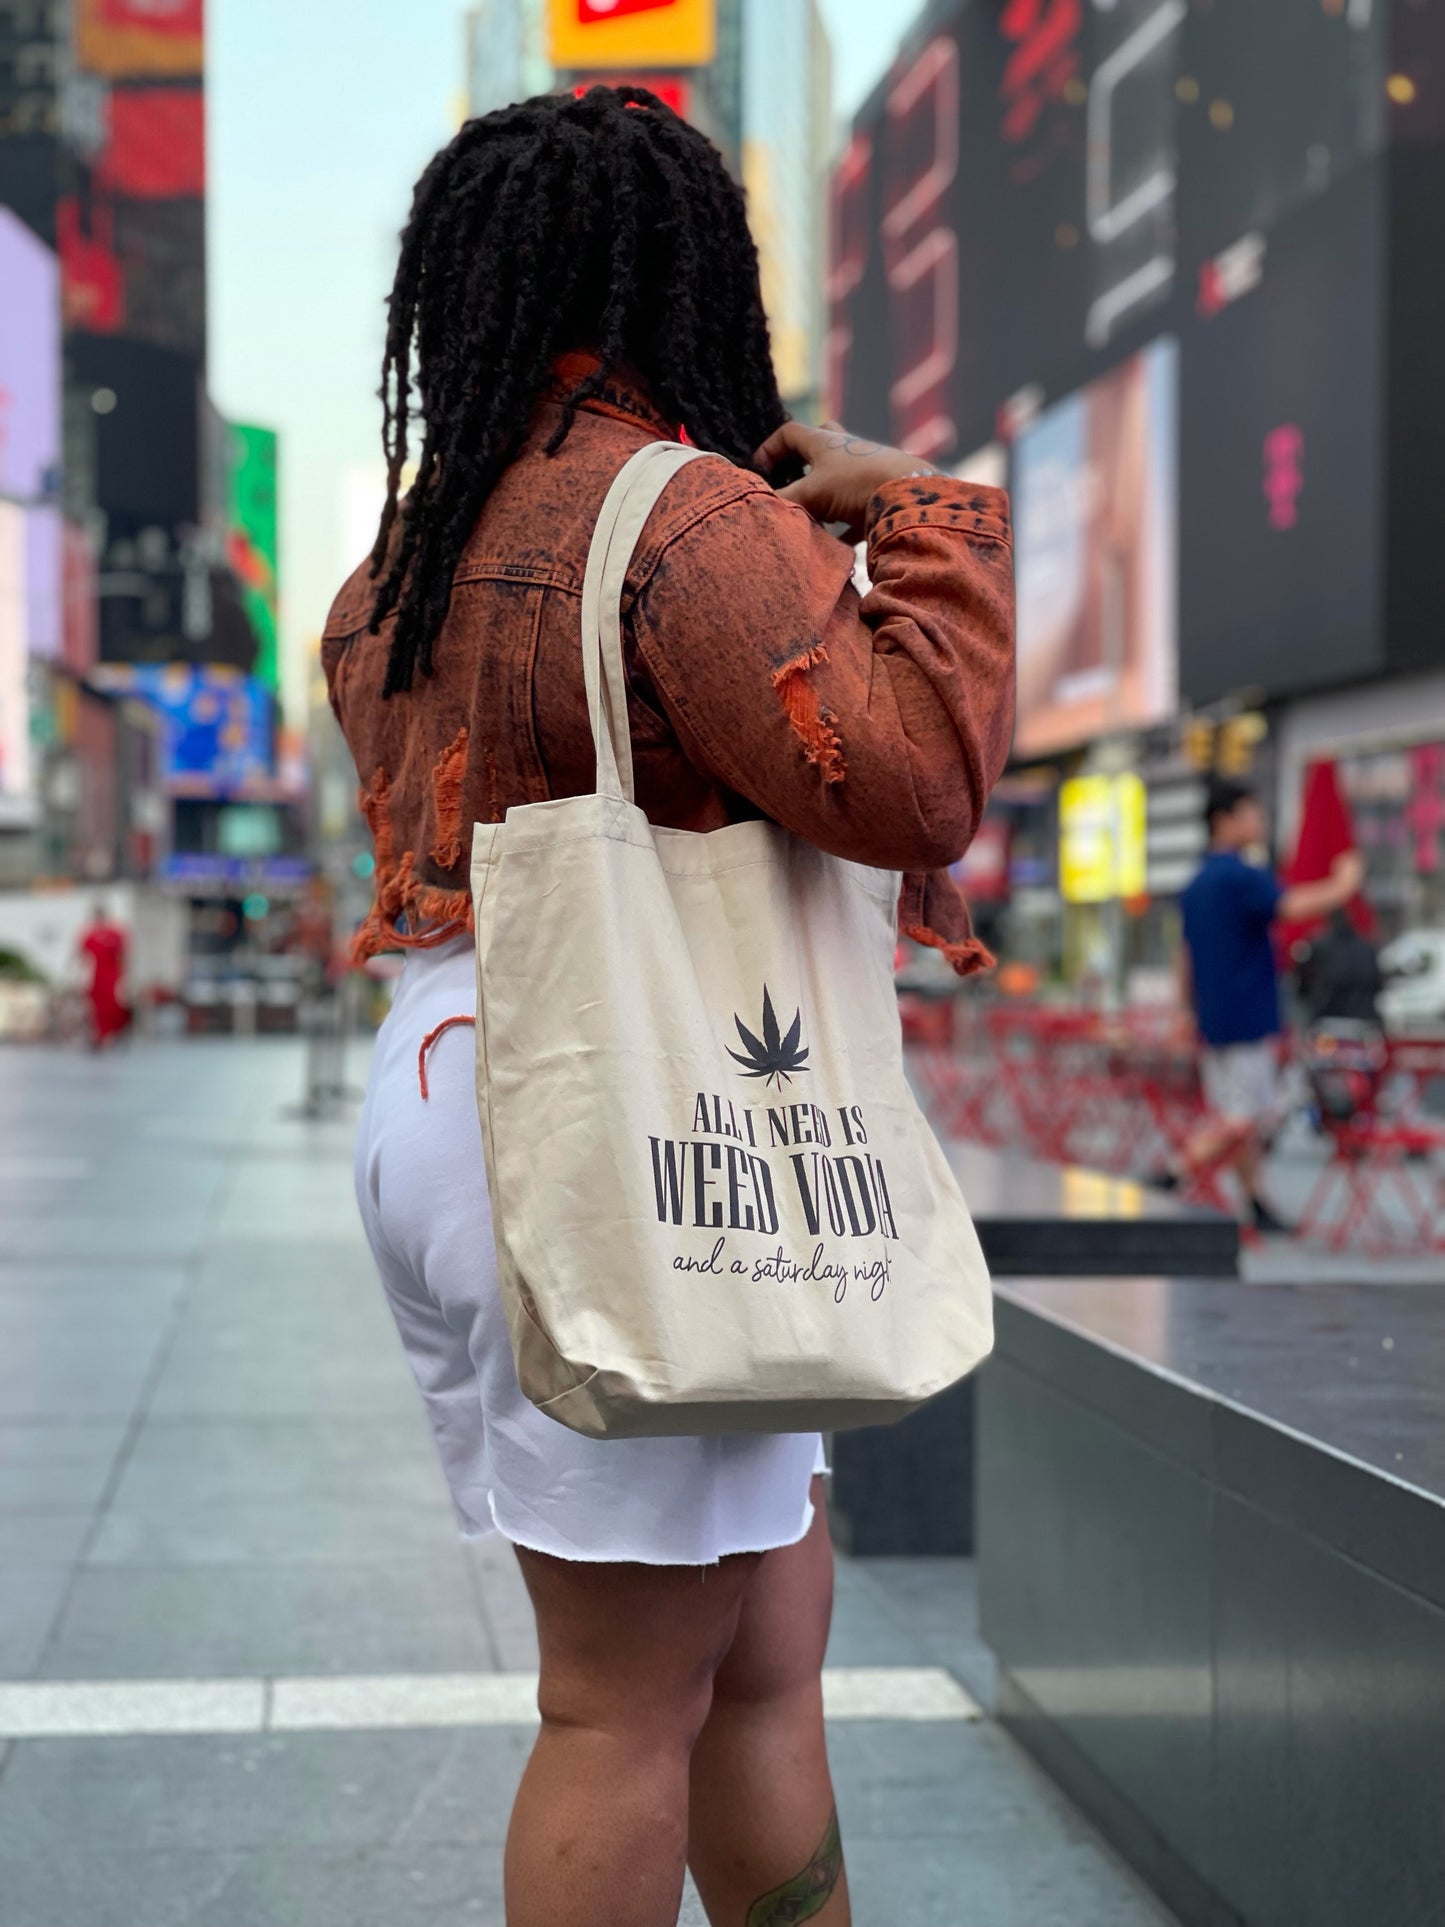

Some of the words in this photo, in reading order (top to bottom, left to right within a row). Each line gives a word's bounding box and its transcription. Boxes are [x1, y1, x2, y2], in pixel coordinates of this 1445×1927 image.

[692, 1092, 743, 1142] ALL
[743, 1108, 758, 1147] I
[837, 1105, 868, 1146] IS
[647, 1135, 780, 1236] WEED
[673, 1236, 724, 1275] and
[730, 1259, 748, 1275] a
[751, 1242, 848, 1303] saturday
[853, 1244, 892, 1302] nig
